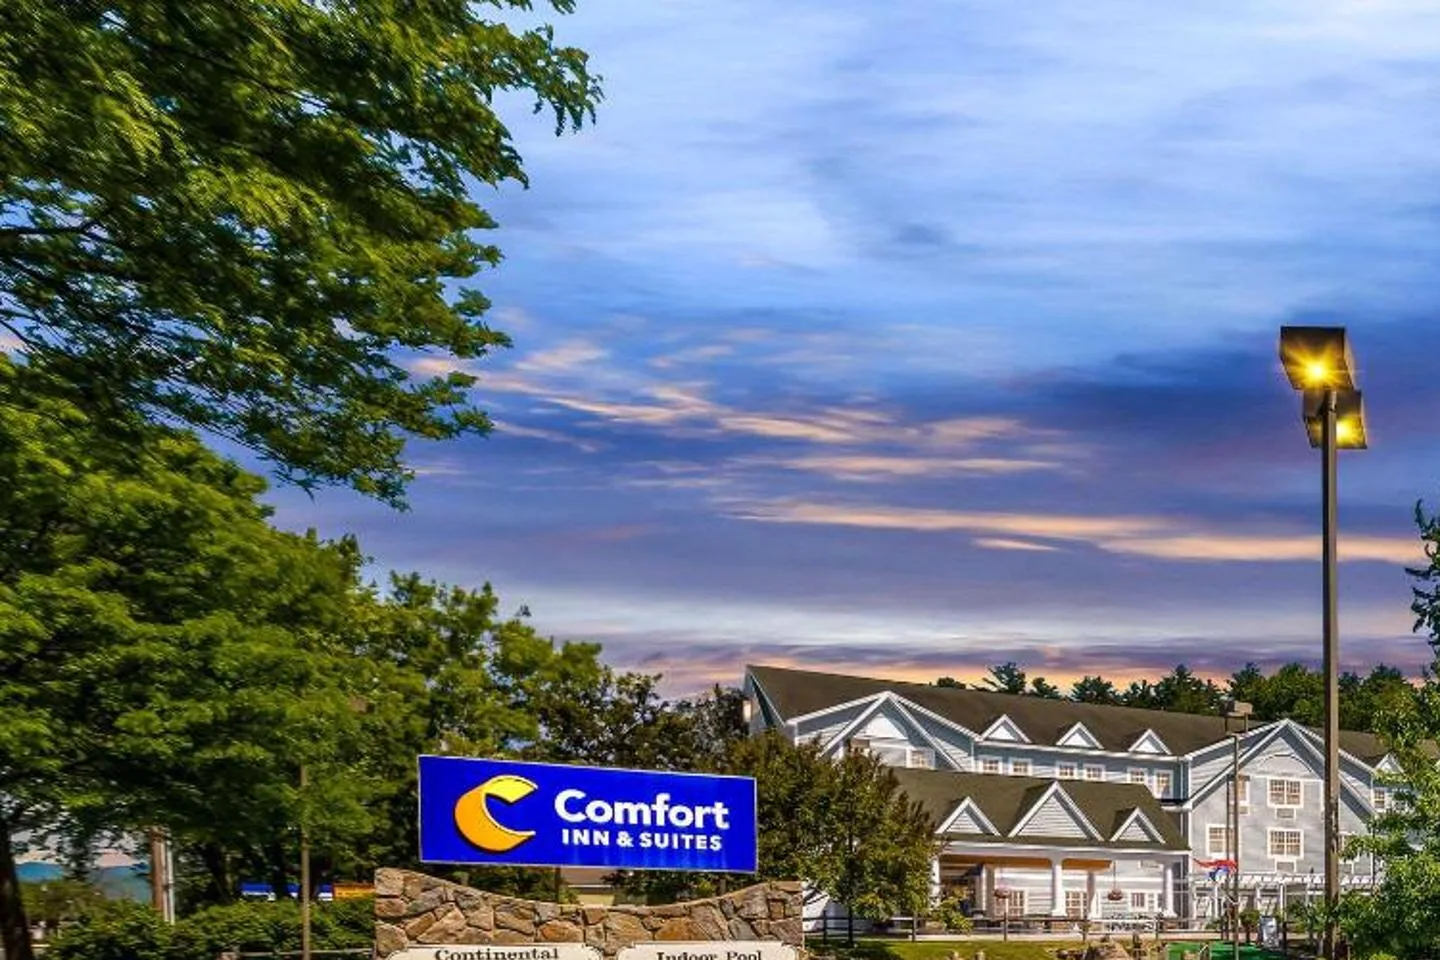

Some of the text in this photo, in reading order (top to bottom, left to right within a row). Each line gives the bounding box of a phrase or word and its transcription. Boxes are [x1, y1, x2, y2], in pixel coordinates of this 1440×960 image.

[554, 788, 730, 829] Comfort
[562, 828, 723, 851] INN & SUITES
